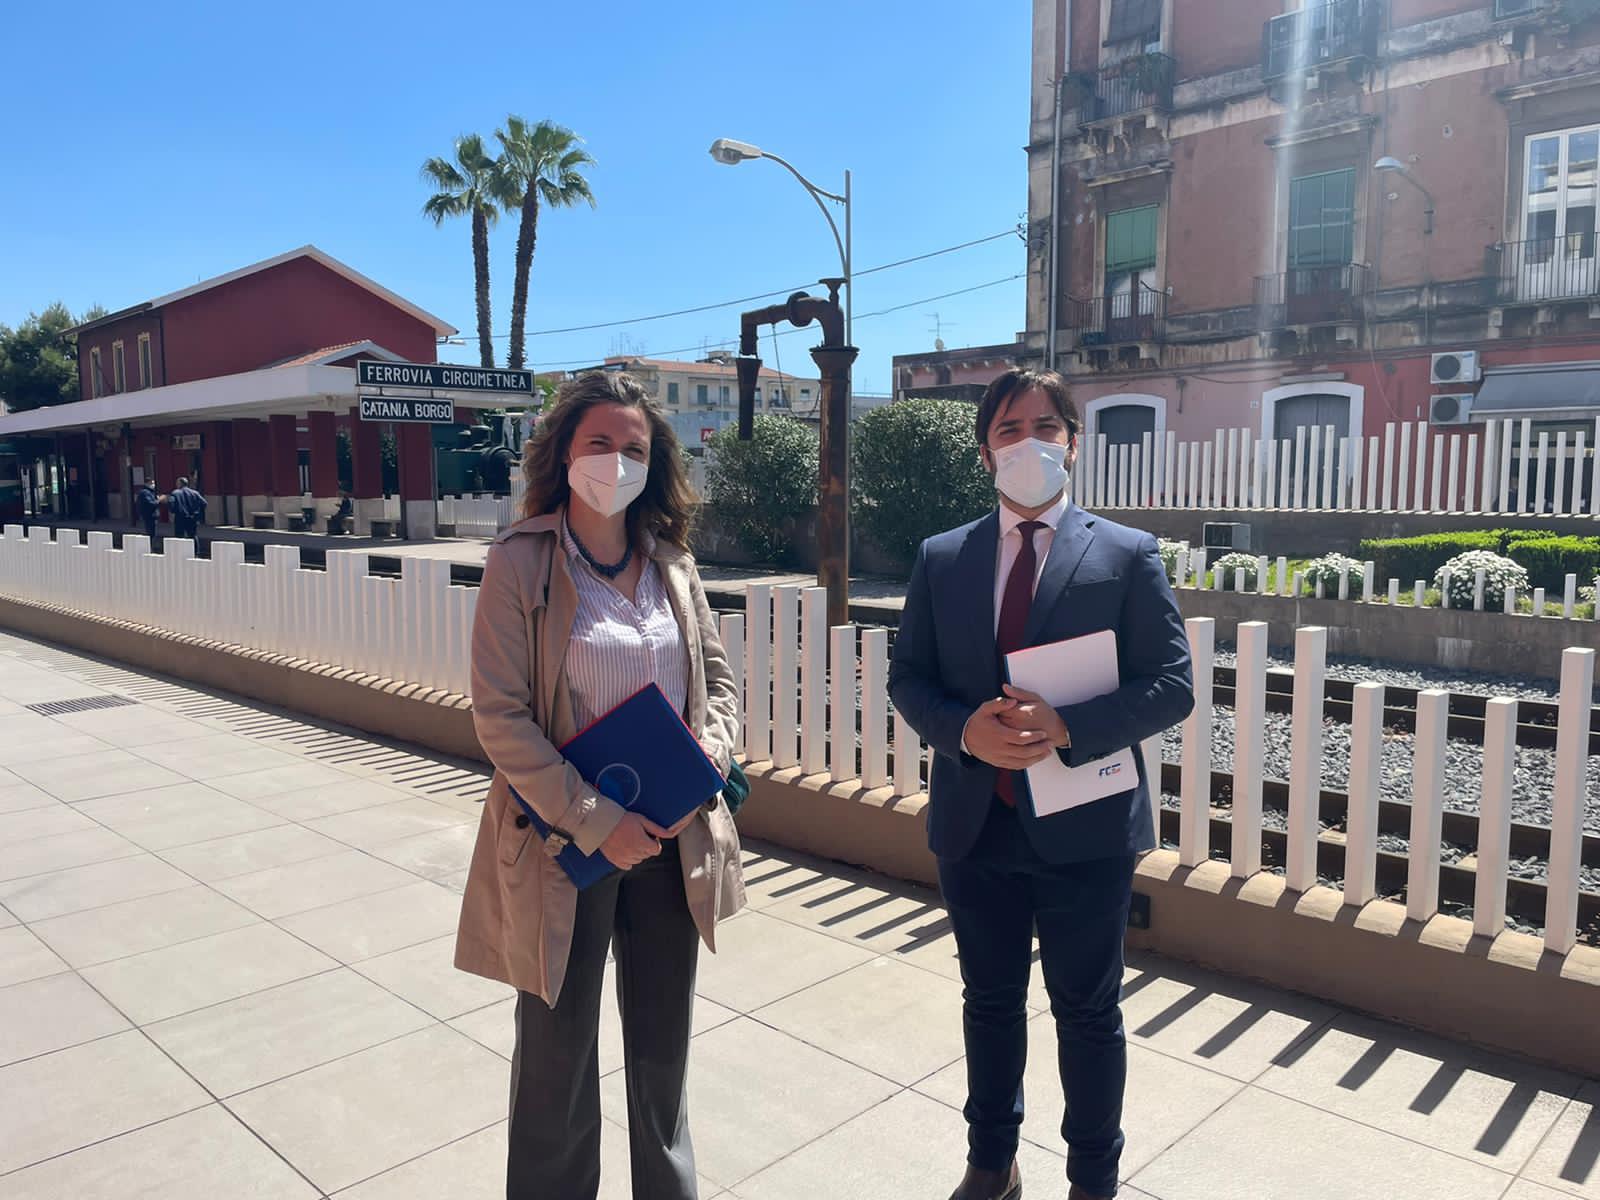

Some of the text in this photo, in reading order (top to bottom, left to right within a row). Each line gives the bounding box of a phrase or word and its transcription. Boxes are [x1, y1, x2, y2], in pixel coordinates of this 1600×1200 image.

[367, 366, 527, 389] FERROVIA CIRCUMETNEA
[362, 401, 451, 419] CATANIA BORGO
